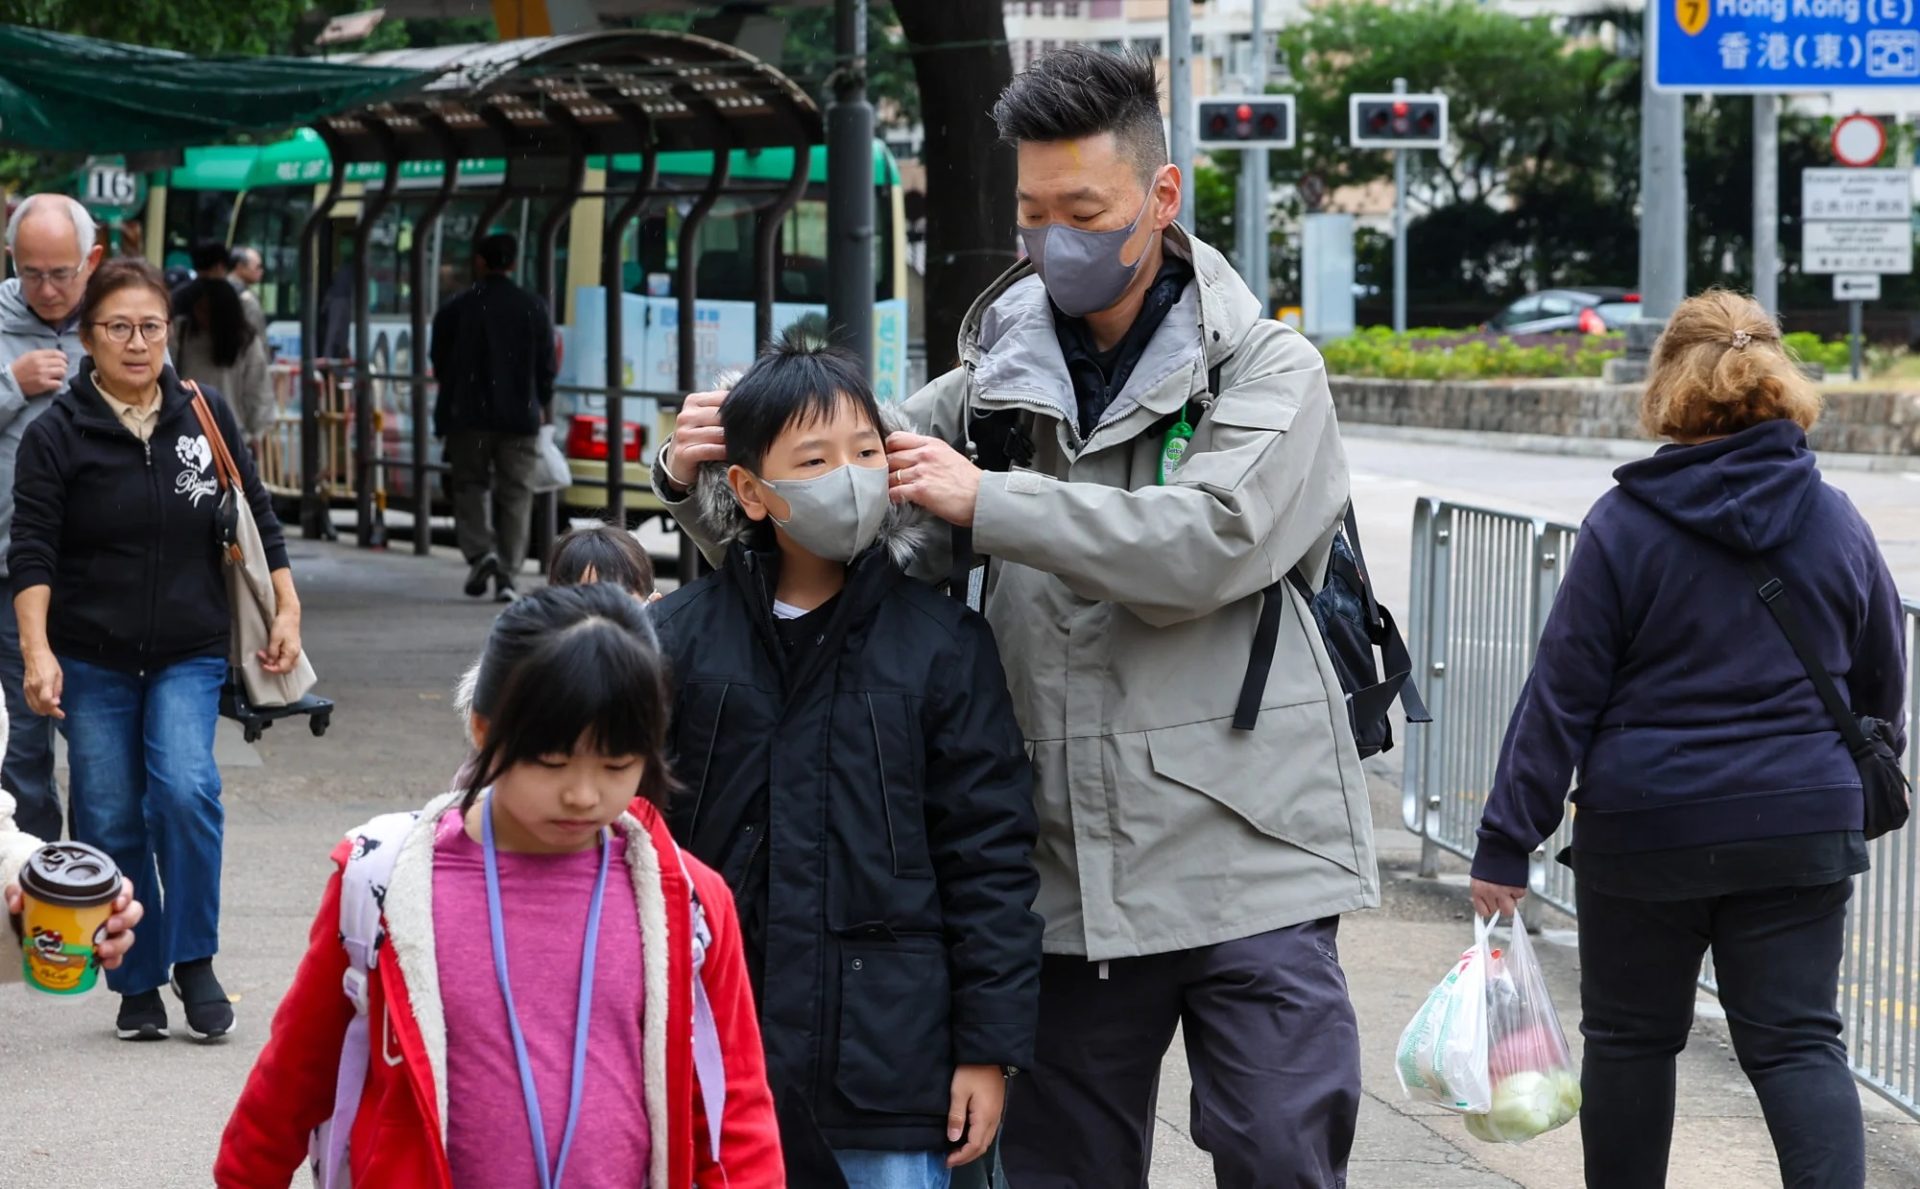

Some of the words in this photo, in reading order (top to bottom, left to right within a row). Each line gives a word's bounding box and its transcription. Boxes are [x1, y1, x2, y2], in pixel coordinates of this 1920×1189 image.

[1685, 2, 1701, 26] 7
[1716, 0, 1787, 23] Hong
[1793, 0, 1860, 24] Kong
[1866, 0, 1913, 25] (E)
[1718, 32, 1862, 70] 香港(東)
[95, 171, 132, 200] 16
